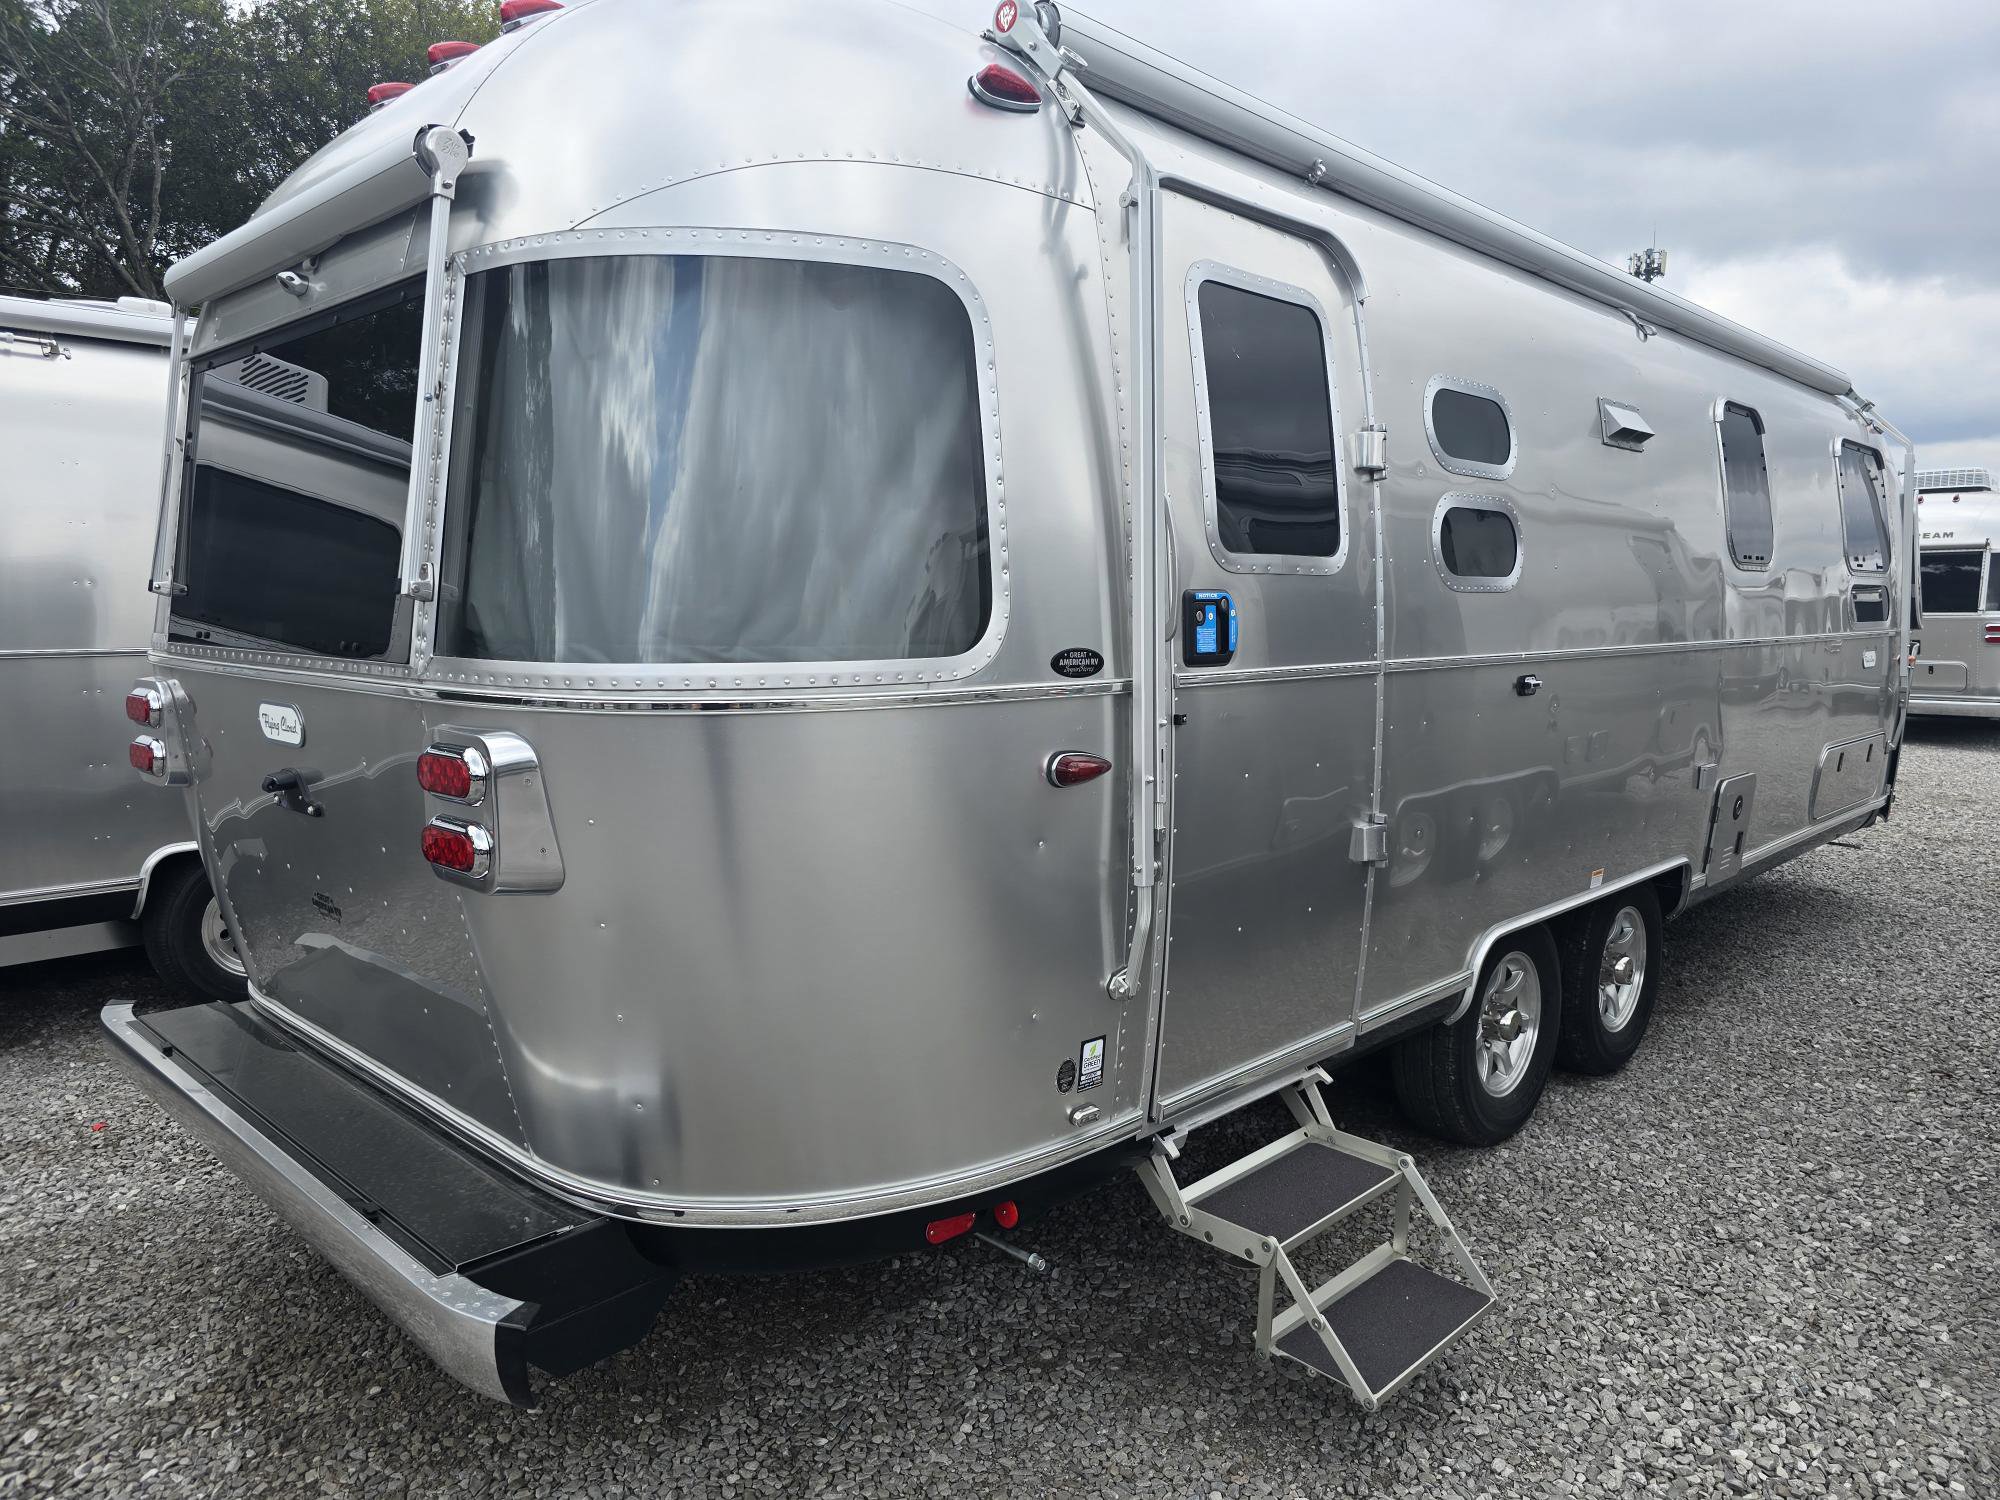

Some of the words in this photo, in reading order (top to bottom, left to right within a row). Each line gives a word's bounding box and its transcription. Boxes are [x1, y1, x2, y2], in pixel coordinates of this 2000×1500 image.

[1919, 531, 1954, 539] EAM
[1059, 658, 1090, 666] AMERICAN
[262, 713, 280, 736] Flying
[281, 715, 298, 734] Cloud
[1083, 1059, 1100, 1069] GREEN
